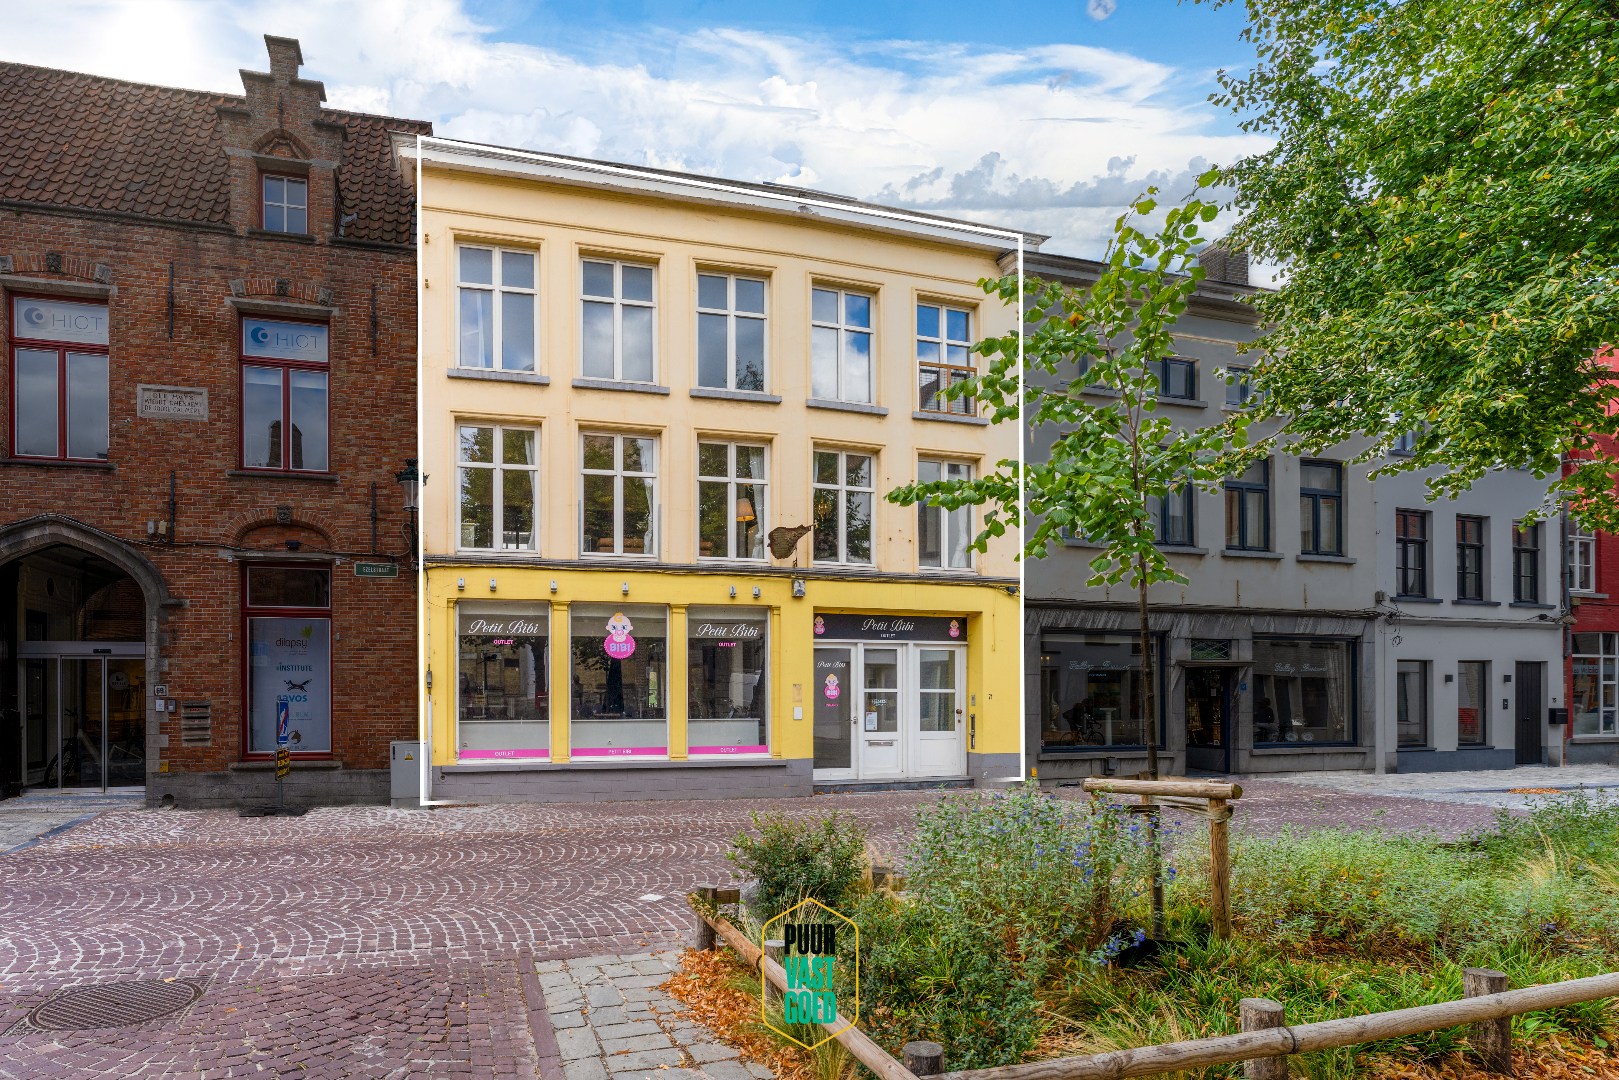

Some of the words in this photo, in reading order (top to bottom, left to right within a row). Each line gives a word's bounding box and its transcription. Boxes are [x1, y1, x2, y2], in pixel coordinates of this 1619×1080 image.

[52, 313, 103, 331] HICT
[276, 332, 321, 349] HICT
[468, 619, 503, 635] Petit
[506, 619, 540, 635] Bibi
[695, 623, 728, 638] Petit
[729, 623, 760, 638] Bibi
[861, 618, 888, 632] Petit
[889, 619, 915, 632] Bibi
[609, 643, 632, 653] BIBI
